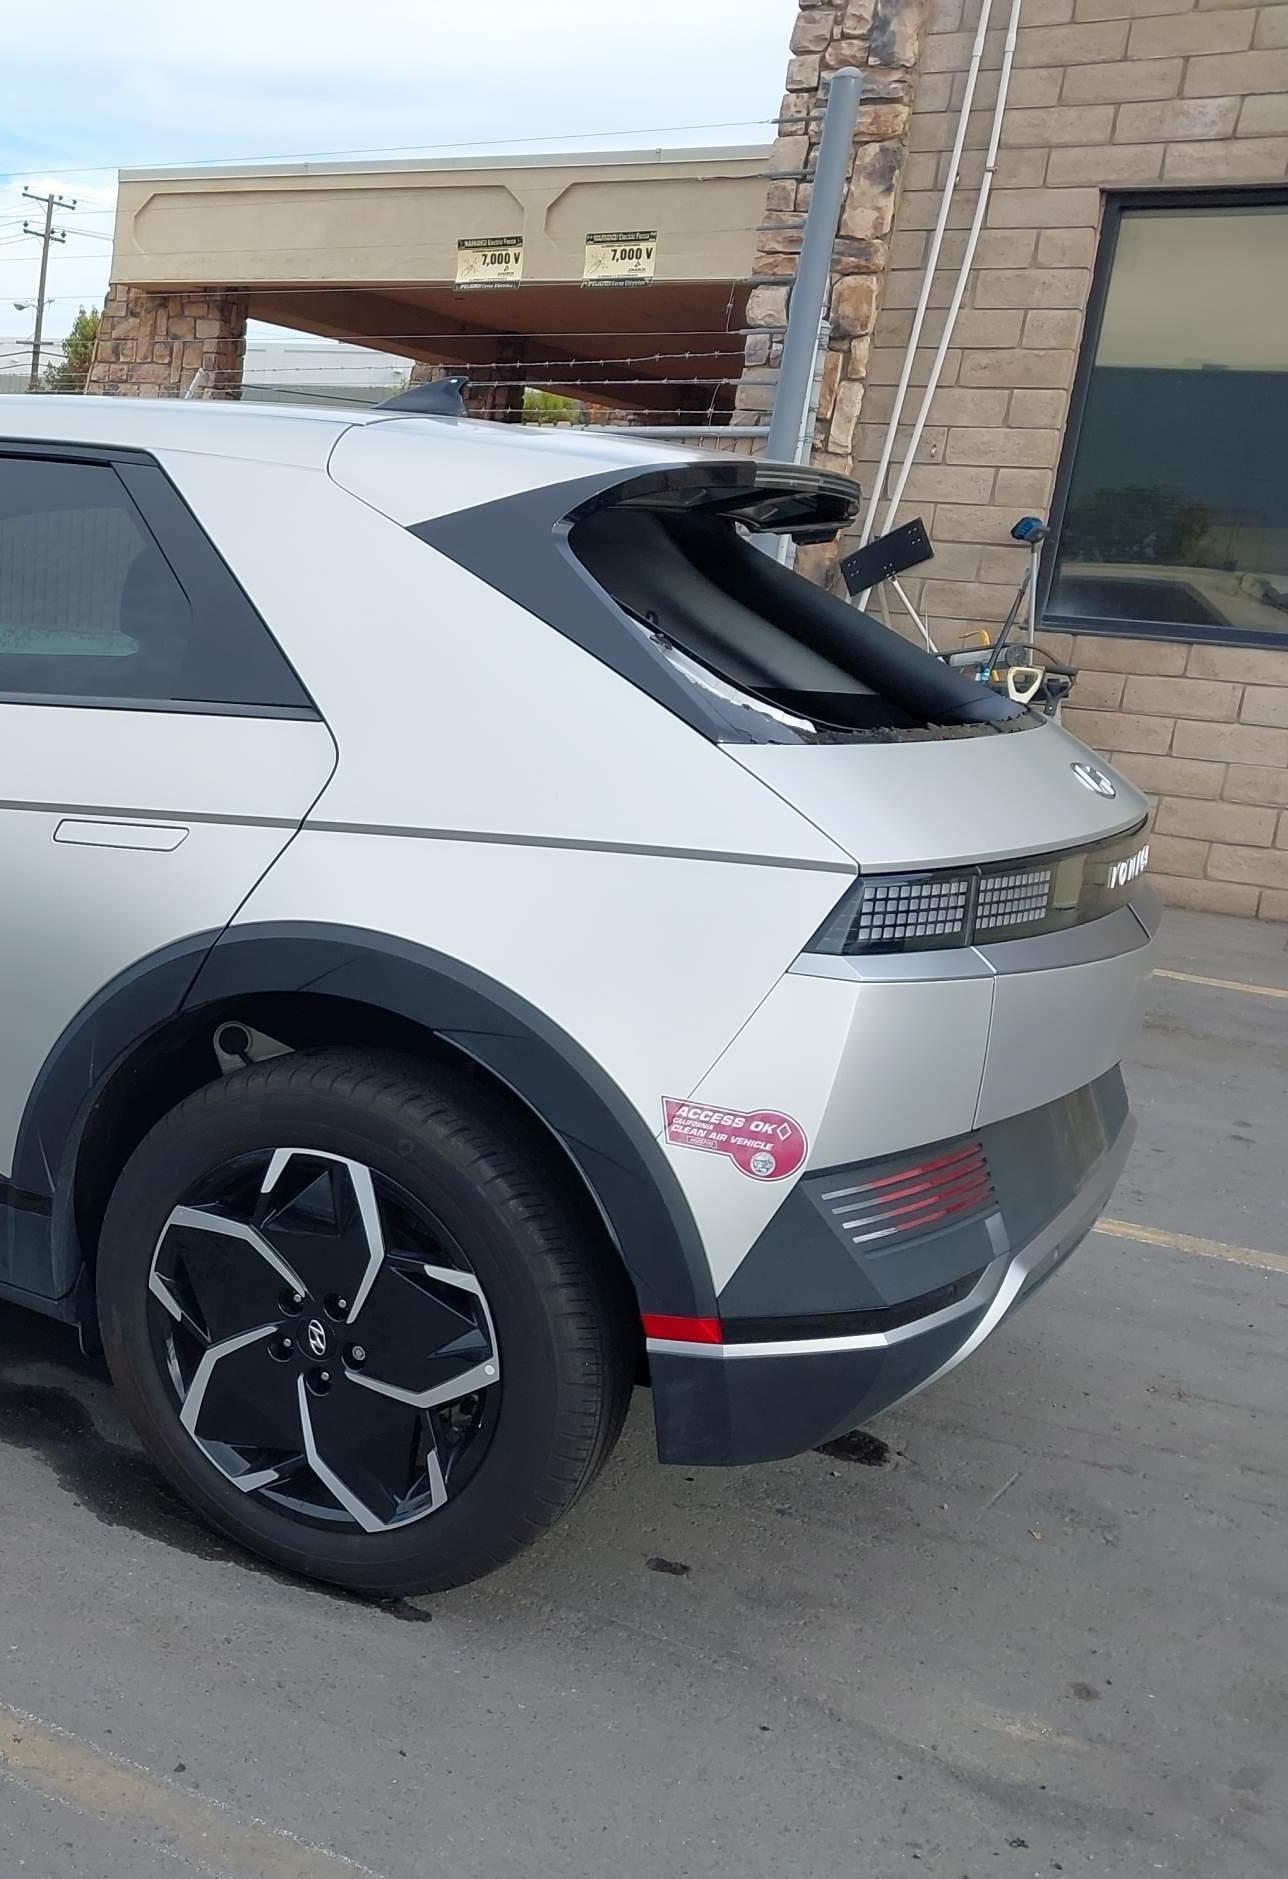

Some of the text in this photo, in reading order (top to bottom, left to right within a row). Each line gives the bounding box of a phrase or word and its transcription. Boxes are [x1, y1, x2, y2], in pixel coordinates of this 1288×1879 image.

[481, 252, 521, 267] 7,000 V
[611, 247, 654, 263] 7,000 V
[672, 1117, 715, 1131] CALIFORNIA
[675, 1106, 778, 1134] ACCESS OK
[671, 1124, 708, 1138] CLEAN
[708, 1132, 729, 1142] AIR
[730, 1135, 775, 1152] VEHICLE
